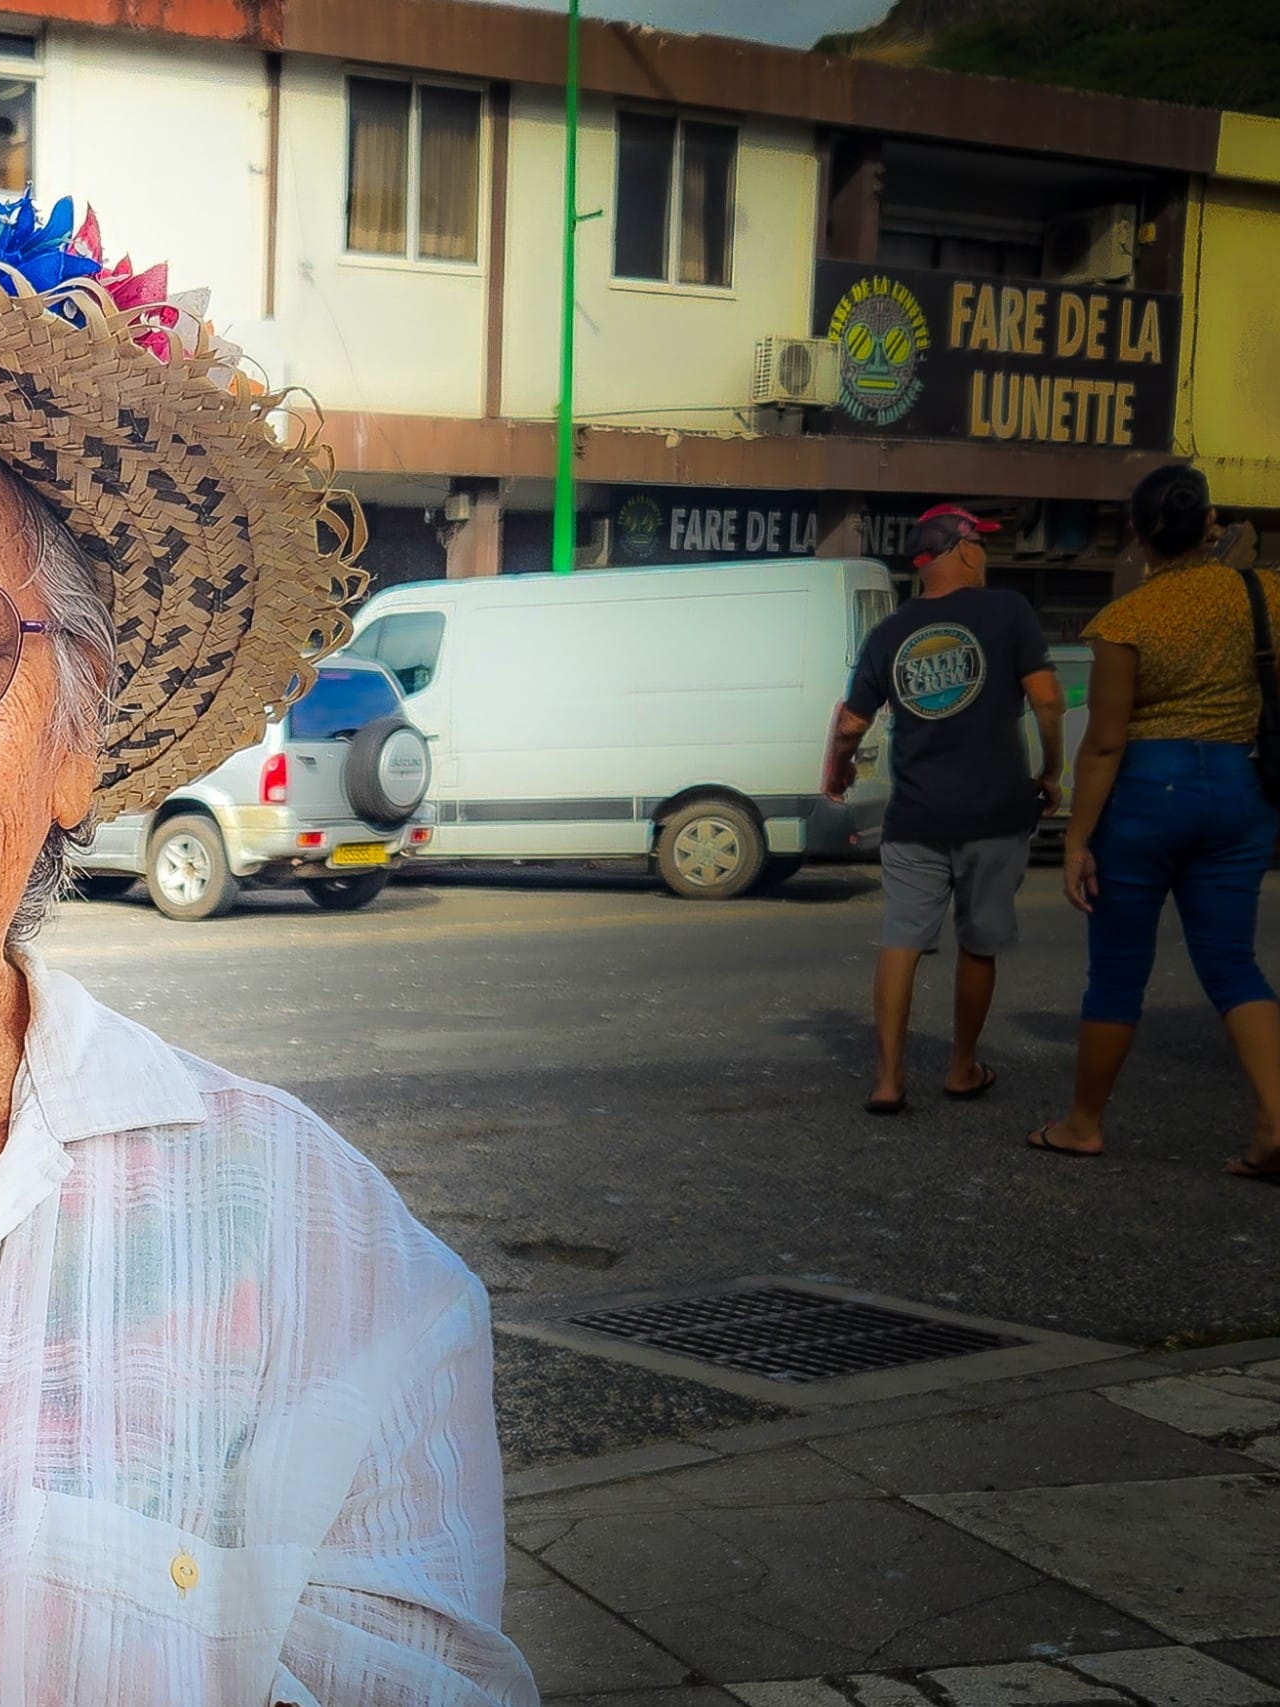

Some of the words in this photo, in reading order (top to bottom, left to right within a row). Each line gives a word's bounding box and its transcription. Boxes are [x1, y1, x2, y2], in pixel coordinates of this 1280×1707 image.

[948, 280, 1046, 354] FARE
[1056, 291, 1109, 360] DE
[1118, 297, 1162, 364] LA
[969, 369, 1135, 445] LUNETTE
[670, 508, 737, 551] FARE
[745, 511, 782, 552] DE
[789, 512, 817, 553] LA
[905, 647, 969, 677] SALTY
